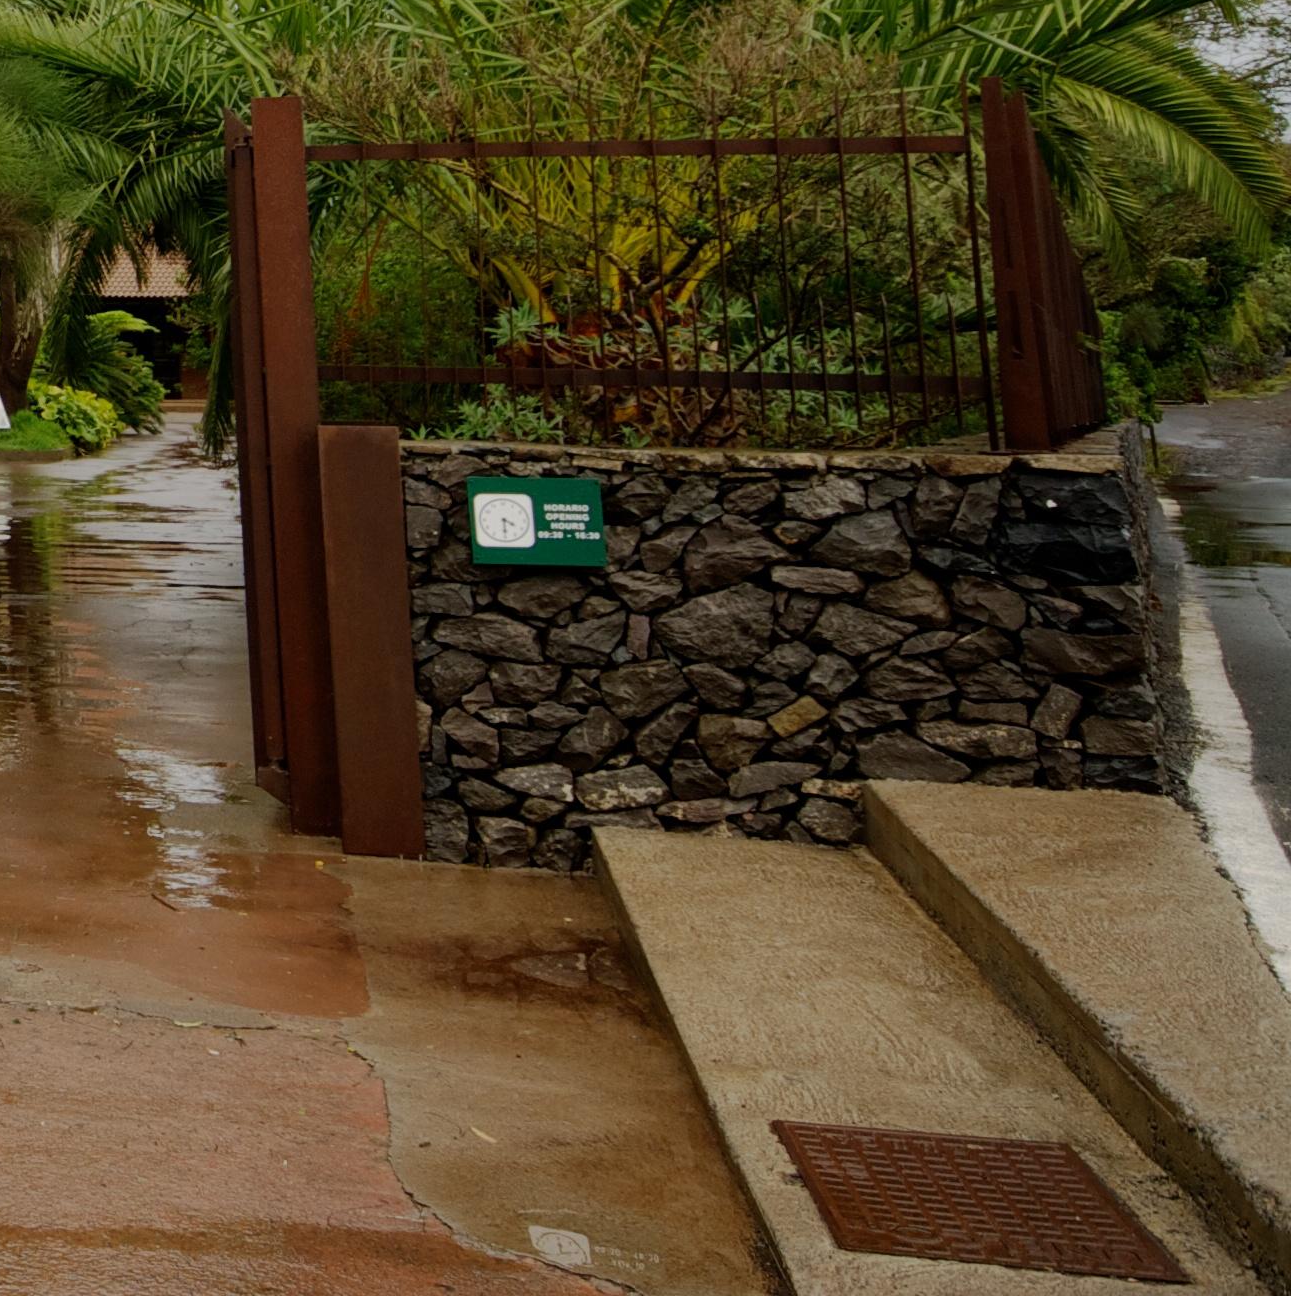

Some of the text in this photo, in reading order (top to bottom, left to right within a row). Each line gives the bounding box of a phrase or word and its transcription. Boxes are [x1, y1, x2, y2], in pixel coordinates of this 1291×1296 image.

[544, 504, 589, 512] HORARIO
[546, 513, 589, 522] OPENING
[551, 522, 585, 530] HOURS
